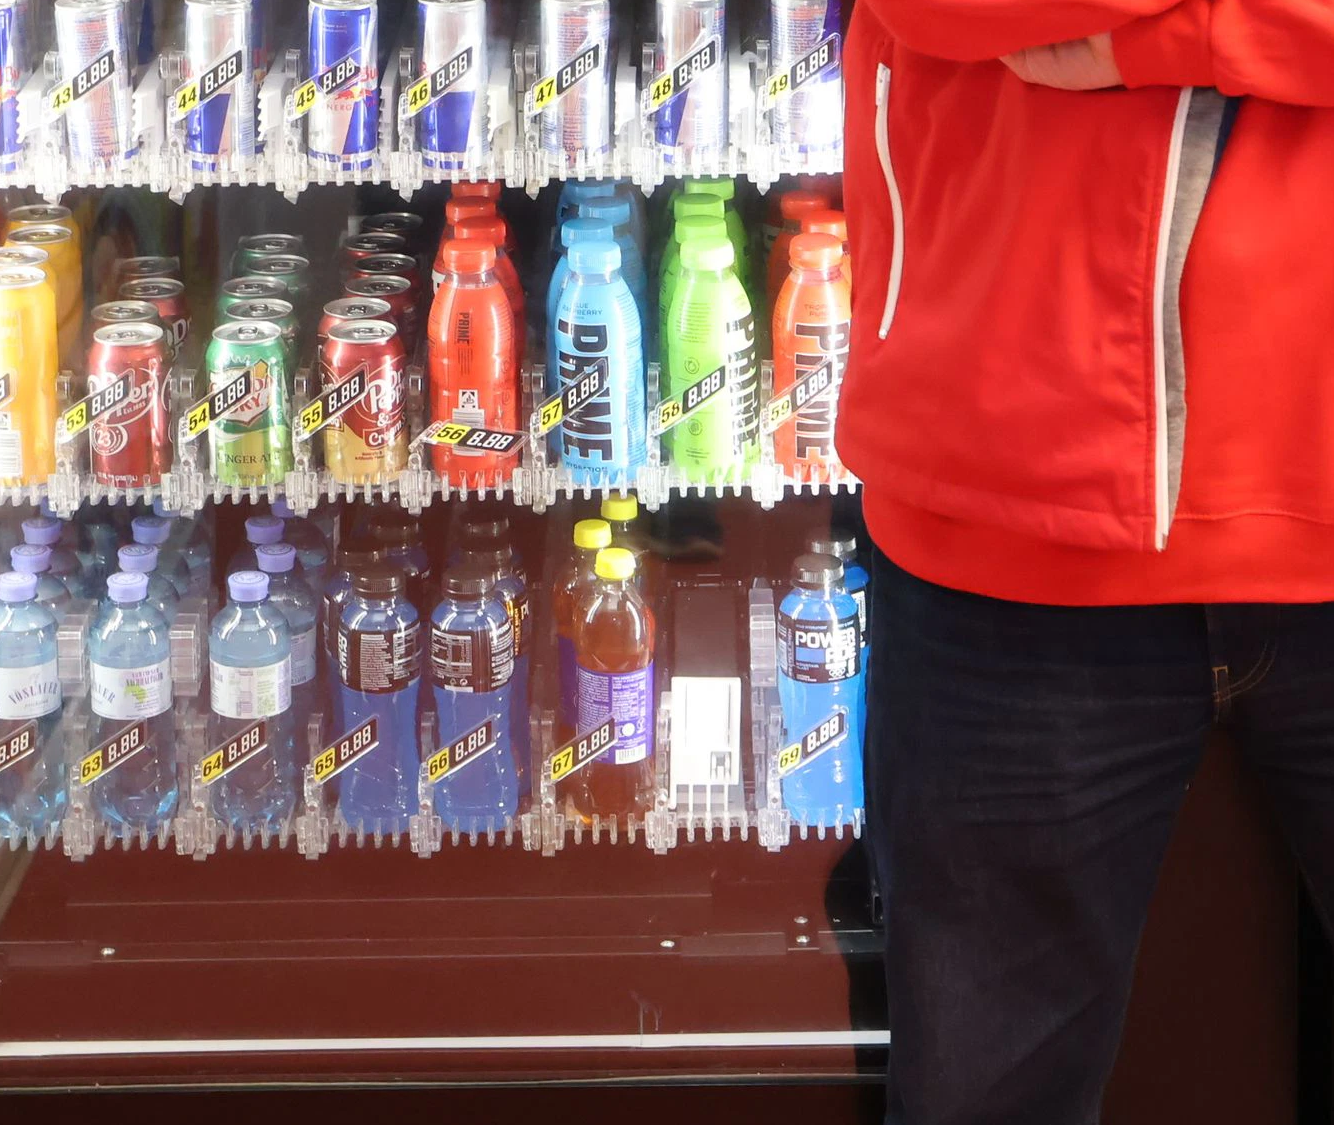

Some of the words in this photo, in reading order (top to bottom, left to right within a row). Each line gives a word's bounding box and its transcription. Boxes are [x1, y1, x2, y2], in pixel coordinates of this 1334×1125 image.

[409, 84, 428, 108] 46
[437, 54, 468, 89] 8.88
[536, 81, 554, 103] 47
[562, 52, 594, 87] 8.88
[769, 74, 788, 98] 49
[53, 88, 71, 110] 43
[179, 88, 197, 110] 44
[297, 85, 315, 110] 45
[653, 79, 671, 102] 48
[455, 311, 471, 345] PRIME
[189, 408, 208, 431] 54
[215, 377, 246, 411] 8.88
[543, 403, 562, 426] 57
[568, 372, 599, 408] 8.88
[67, 409, 85, 430] 53
[302, 405, 321, 428] 55
[661, 402, 680, 422] 58
[438, 425, 464, 441] 56
[466, 430, 513, 449] 8.88
[82, 757, 101, 779] 63
[108, 728, 139, 762] 8.88
[203, 756, 222, 778] 64
[228, 728, 259, 762] 8.88
[430, 754, 449, 776] 66
[455, 725, 486, 760] 8.88
[553, 752, 572, 775] 67
[578, 723, 609, 759] 8.88
[780, 746, 799, 767] 69
[315, 753, 334, 775] 65
